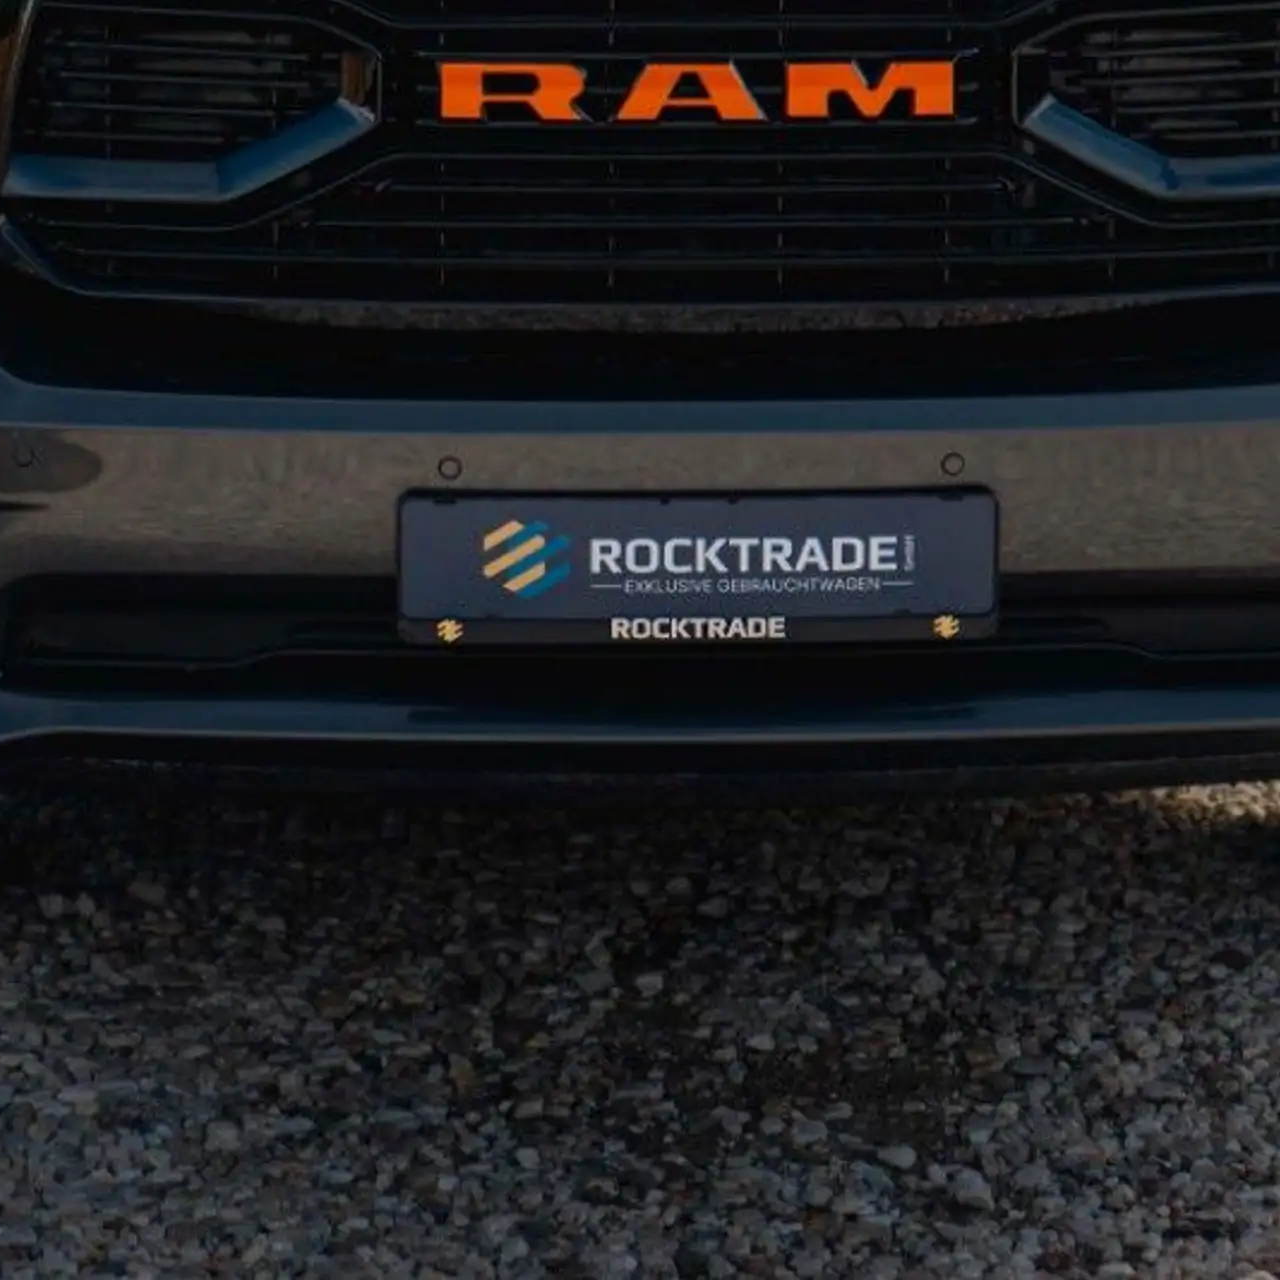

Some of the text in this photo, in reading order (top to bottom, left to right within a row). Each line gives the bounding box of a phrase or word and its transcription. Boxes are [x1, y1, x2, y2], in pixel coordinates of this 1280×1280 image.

[439, 61, 956, 121] RAM
[590, 535, 898, 574] ROCKTRADE
[624, 577, 881, 595] EXKLUSIVE GEBRAUCHTWAGEN
[610, 616, 786, 640] ROCKTRADE
